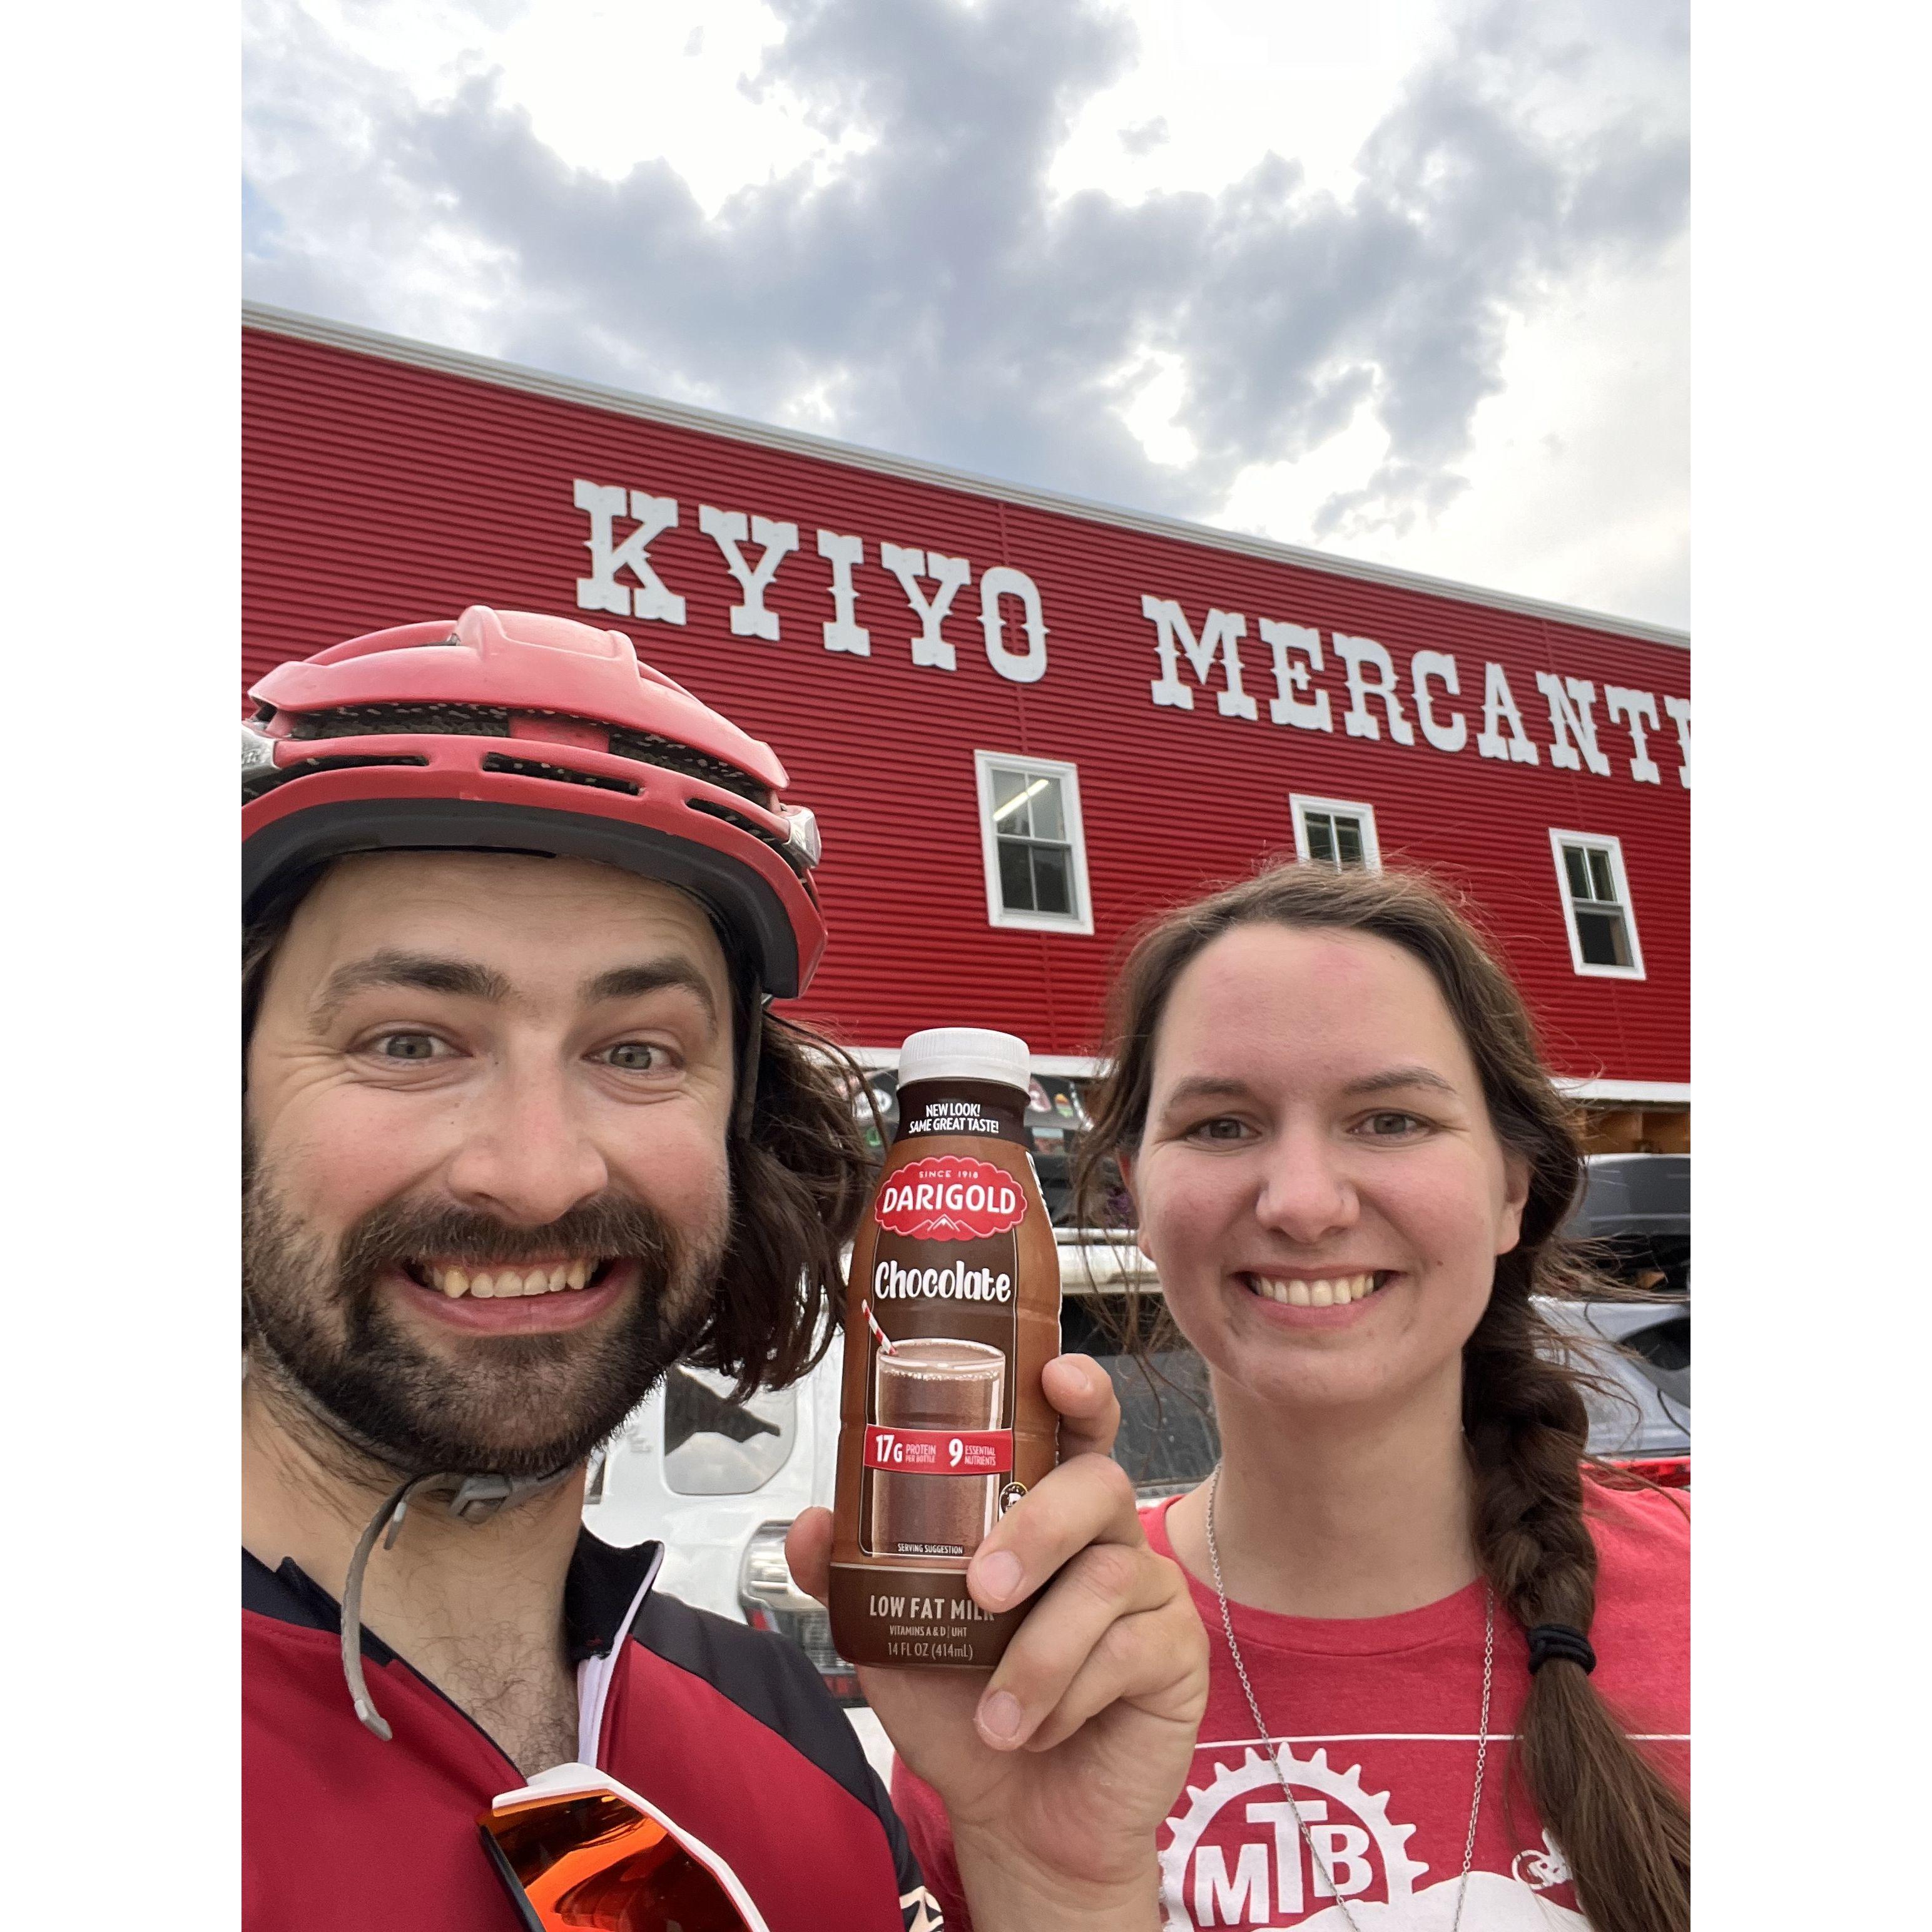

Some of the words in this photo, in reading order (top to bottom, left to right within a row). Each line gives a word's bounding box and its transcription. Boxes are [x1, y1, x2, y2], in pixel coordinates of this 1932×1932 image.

[573, 479, 1050, 683] KYIYO
[926, 1104, 948, 1117] NEW
[950, 1103, 981, 1117] LOOK!
[908, 1119, 932, 1134] SAME
[933, 1117, 966, 1131] GREAT
[967, 1118, 999, 1134] TASTE!
[918, 1170, 952, 1179] SINCE
[958, 1171, 979, 1179] 1918
[882, 1184, 1016, 1214] DARIGOLD
[875, 1260, 1011, 1303] Chocolate
[875, 1434, 903, 1463] 17G
[905, 1443, 937, 1455] PROTEIN
[948, 1438, 963, 1467] 9
[965, 1445, 995, 1457] ESSENTIAL
[916, 1455, 935, 1463] BOTTLE
[964, 1455, 996, 1466] NUTRIENTS
[897, 1543, 923, 1553] SERVING
[924, 1544, 963, 1555] SUGGESTION
[870, 1595, 905, 1618] LOW
[910, 1597, 945, 1619] FAT
[889, 1625, 925, 1636] VITAMINS
[925, 1626, 932, 1636] A
[932, 1626, 939, 1637] &
[951, 1627, 967, 1637] UHT
[888, 1642, 899, 1655] 14
[901, 1642, 913, 1656] FL
[914, 1642, 930, 1656] OZ
[932, 1642, 973, 1660] (414mL)
[1194, 1799, 1374, 1927] MTB
